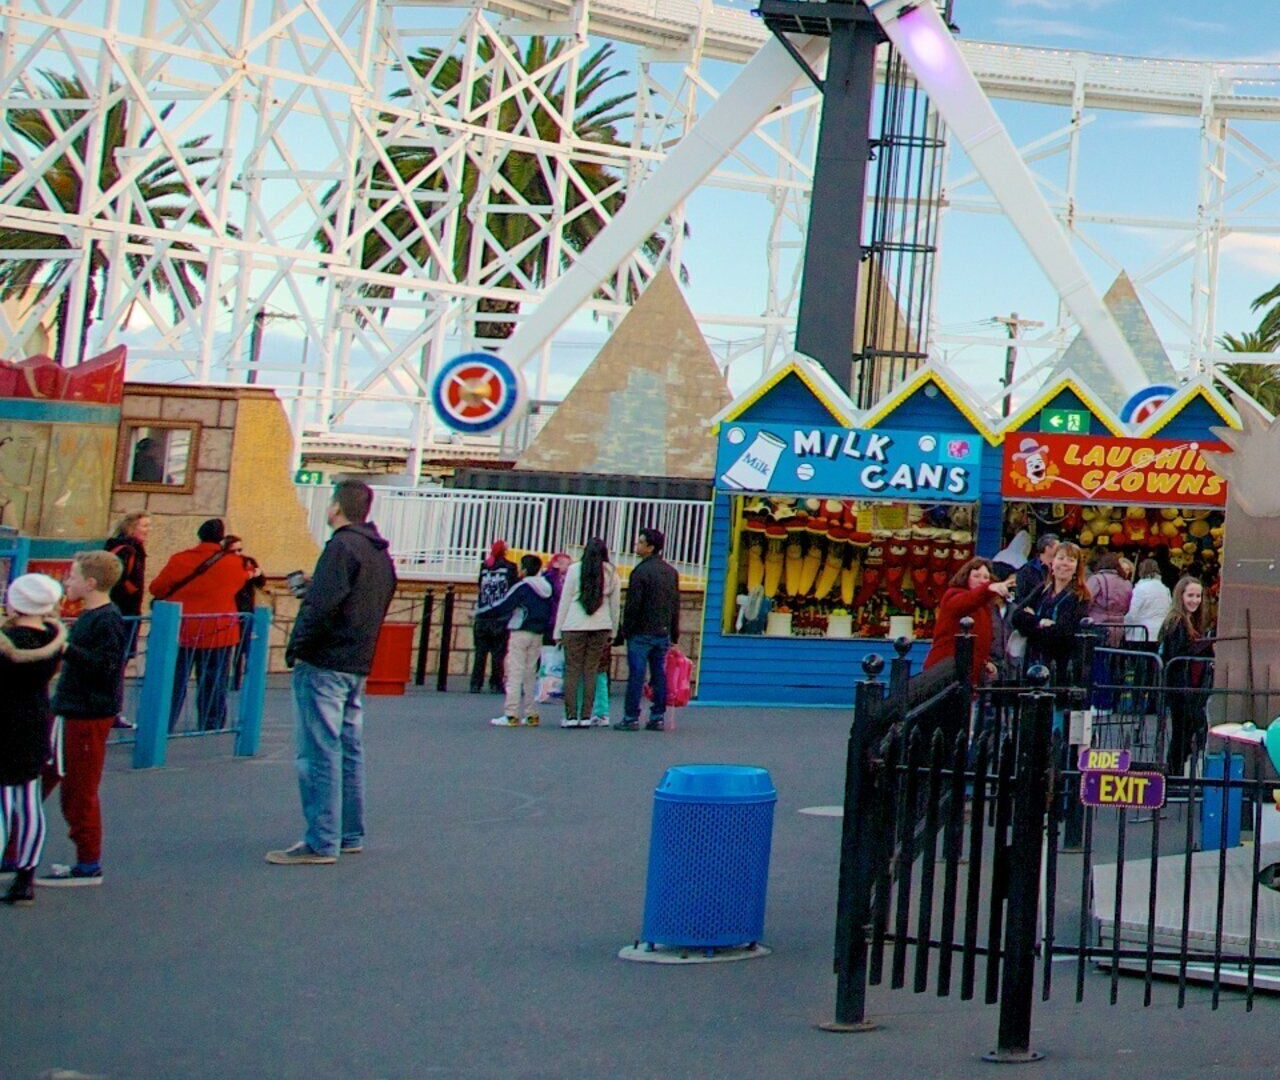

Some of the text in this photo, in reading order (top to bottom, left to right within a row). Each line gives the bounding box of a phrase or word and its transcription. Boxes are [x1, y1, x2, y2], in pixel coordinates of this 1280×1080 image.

[793, 429, 892, 461] MILK
[742, 451, 770, 476] Milk
[860, 463, 967, 494] CANS
[1081, 469, 1226, 496] CLOWNS
[1087, 751, 1121, 769] RIDE
[1099, 774, 1149, 805] EXIT
